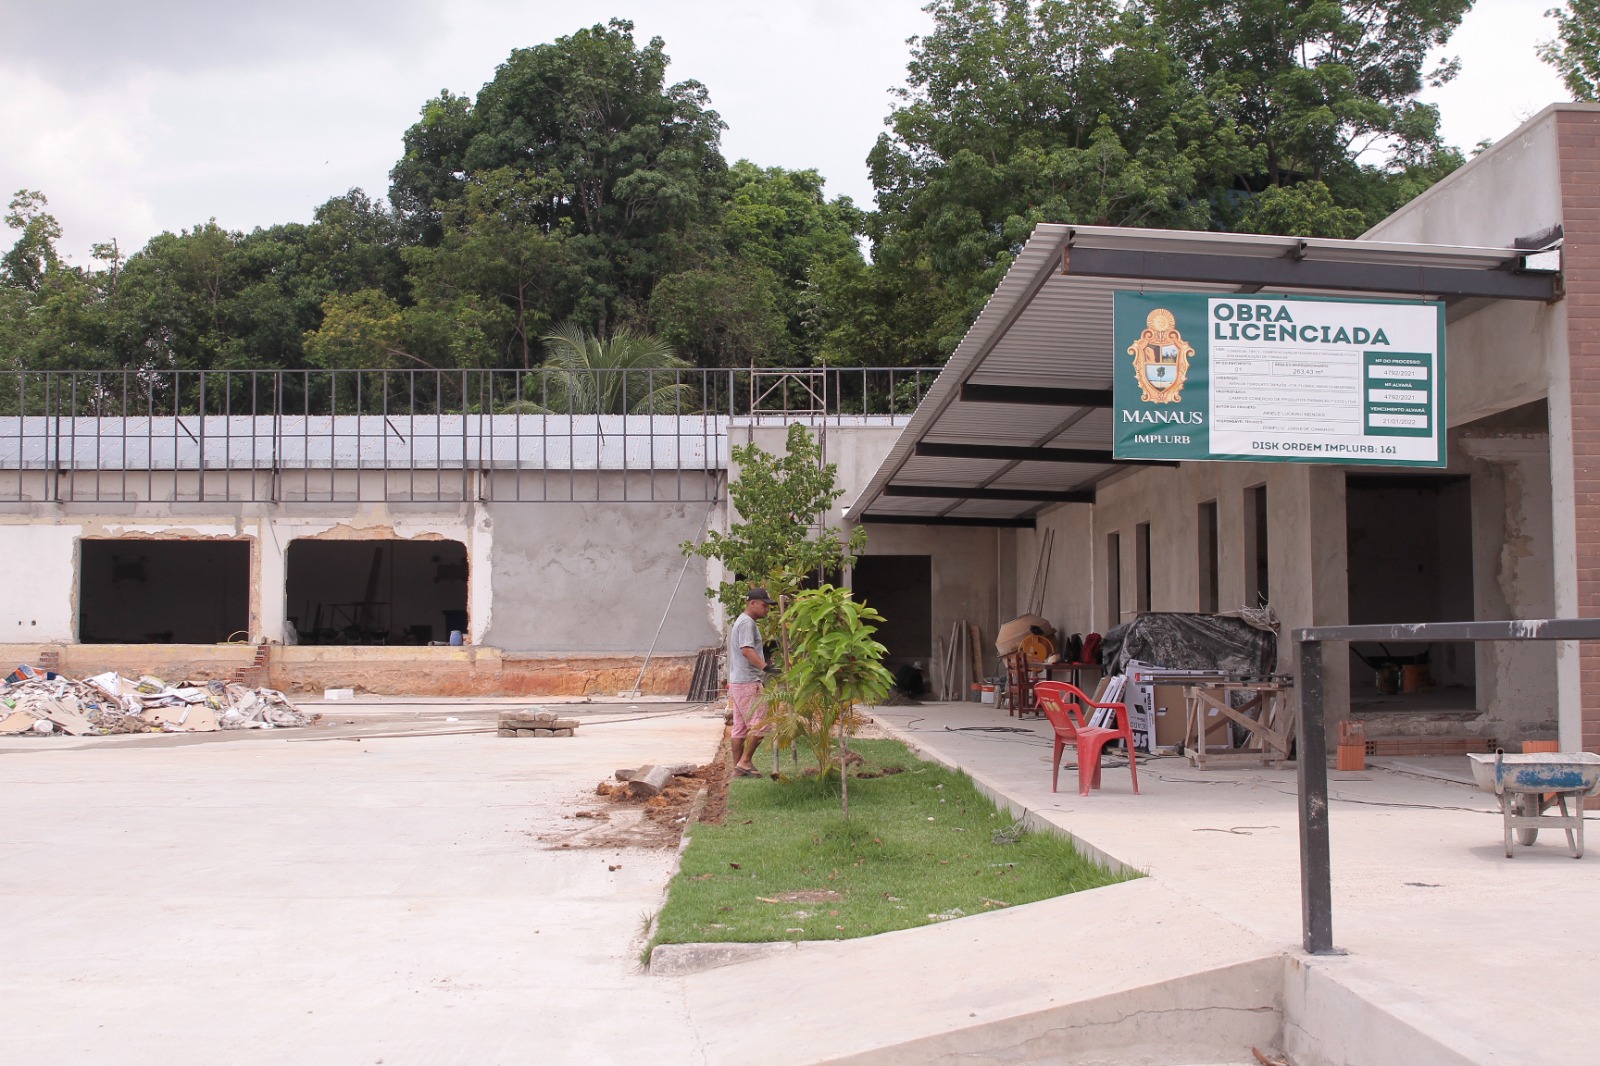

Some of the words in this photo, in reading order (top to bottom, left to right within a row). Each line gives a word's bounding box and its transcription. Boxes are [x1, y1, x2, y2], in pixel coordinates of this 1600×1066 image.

[1214, 303, 1293, 322] OBRA
[1214, 322, 1390, 346] LICENCIADA
[1122, 409, 1203, 425] MANAUS
[1134, 434, 1190, 444] IMPLURB
[1252, 441, 1280, 451] DISK
[1282, 442, 1322, 452] ORDEM
[1324, 443, 1378, 454] IMPLURB:
[1380, 445, 1397, 454] 161
